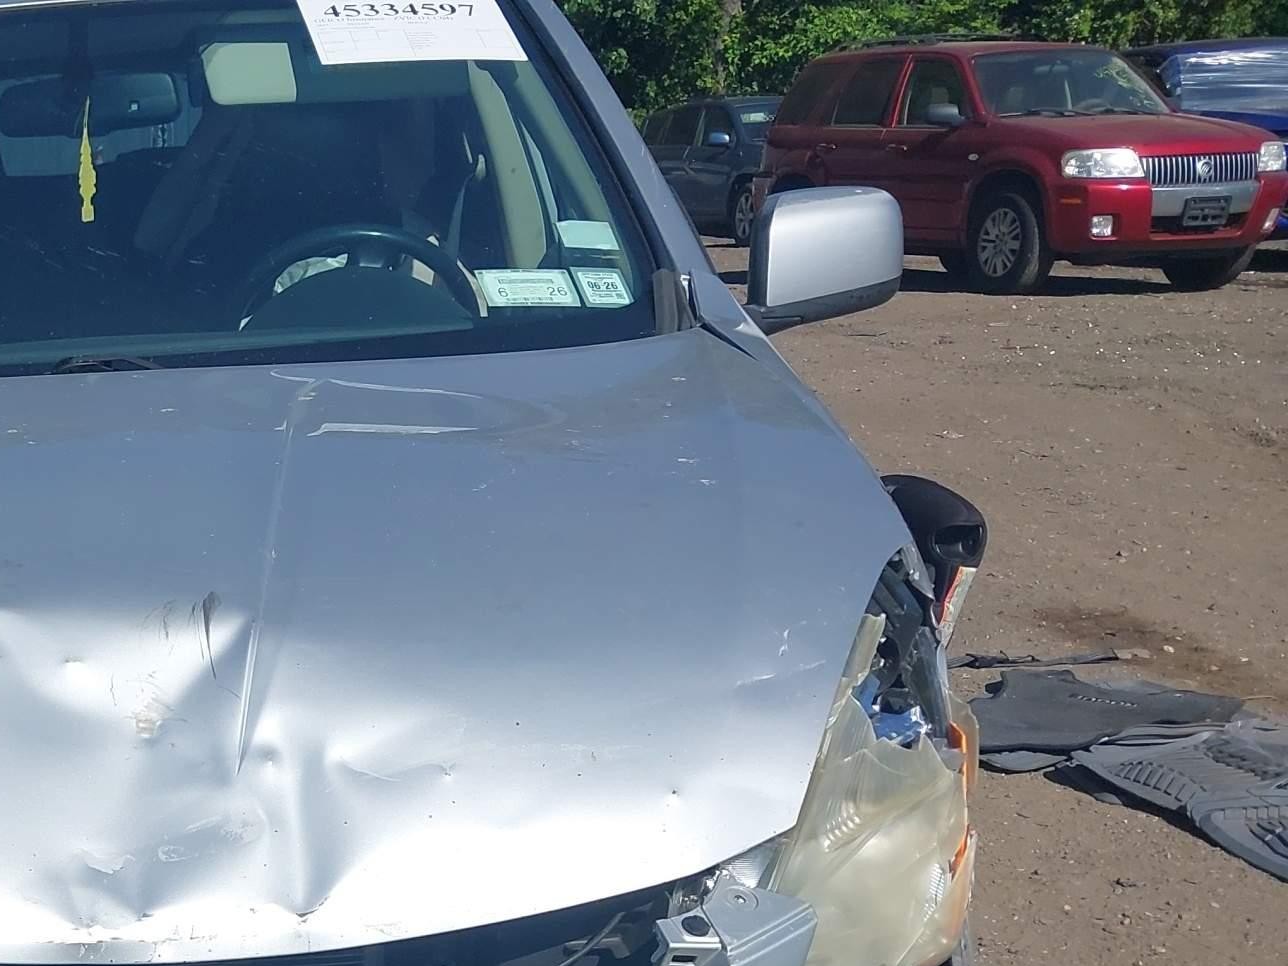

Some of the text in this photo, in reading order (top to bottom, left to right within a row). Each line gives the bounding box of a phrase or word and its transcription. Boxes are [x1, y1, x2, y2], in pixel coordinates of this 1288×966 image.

[323, 2, 474, 18] 45334597
[497, 286, 568, 298] 6 26
